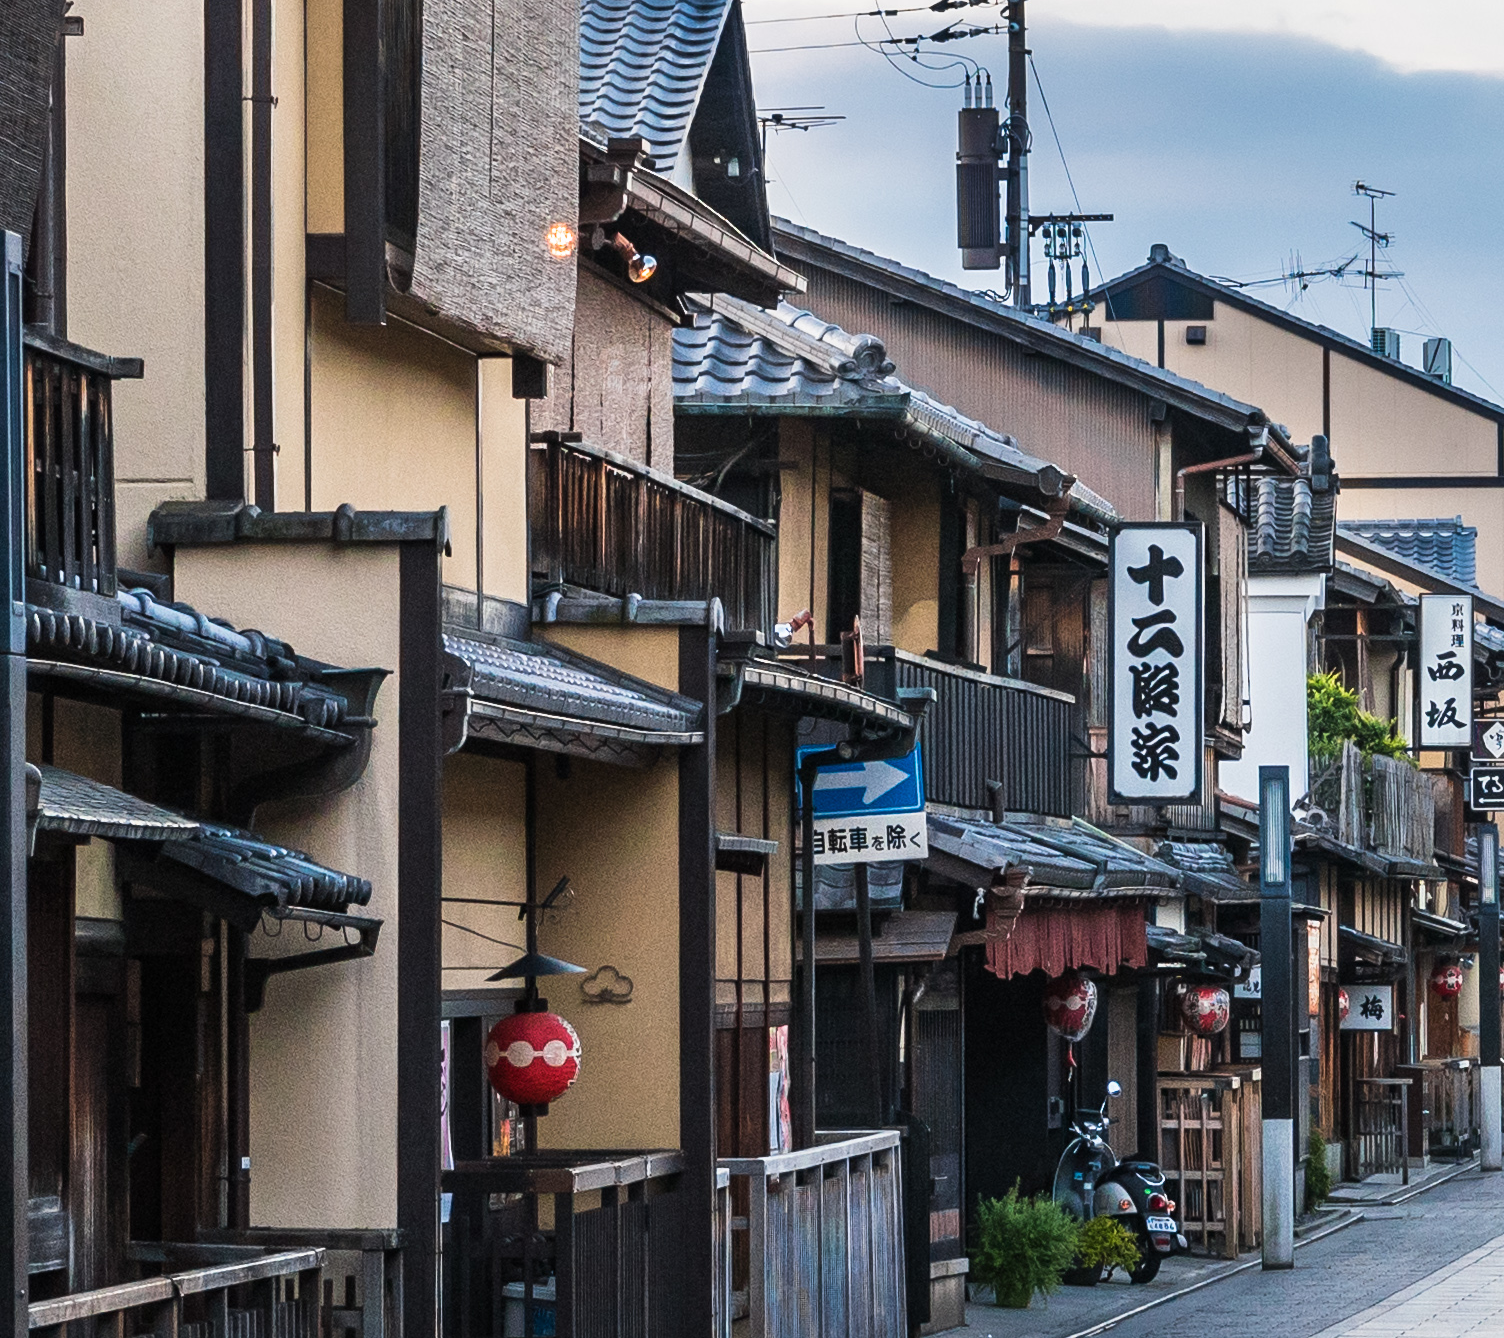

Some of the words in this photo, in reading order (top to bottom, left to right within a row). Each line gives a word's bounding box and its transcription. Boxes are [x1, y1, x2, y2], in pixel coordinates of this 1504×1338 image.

[1451, 602, 1465, 649] 京料理
[1425, 650, 1468, 729] 西坂
[813, 824, 922, 855] 自転車を除く
[1359, 994, 1385, 1021] 梅
